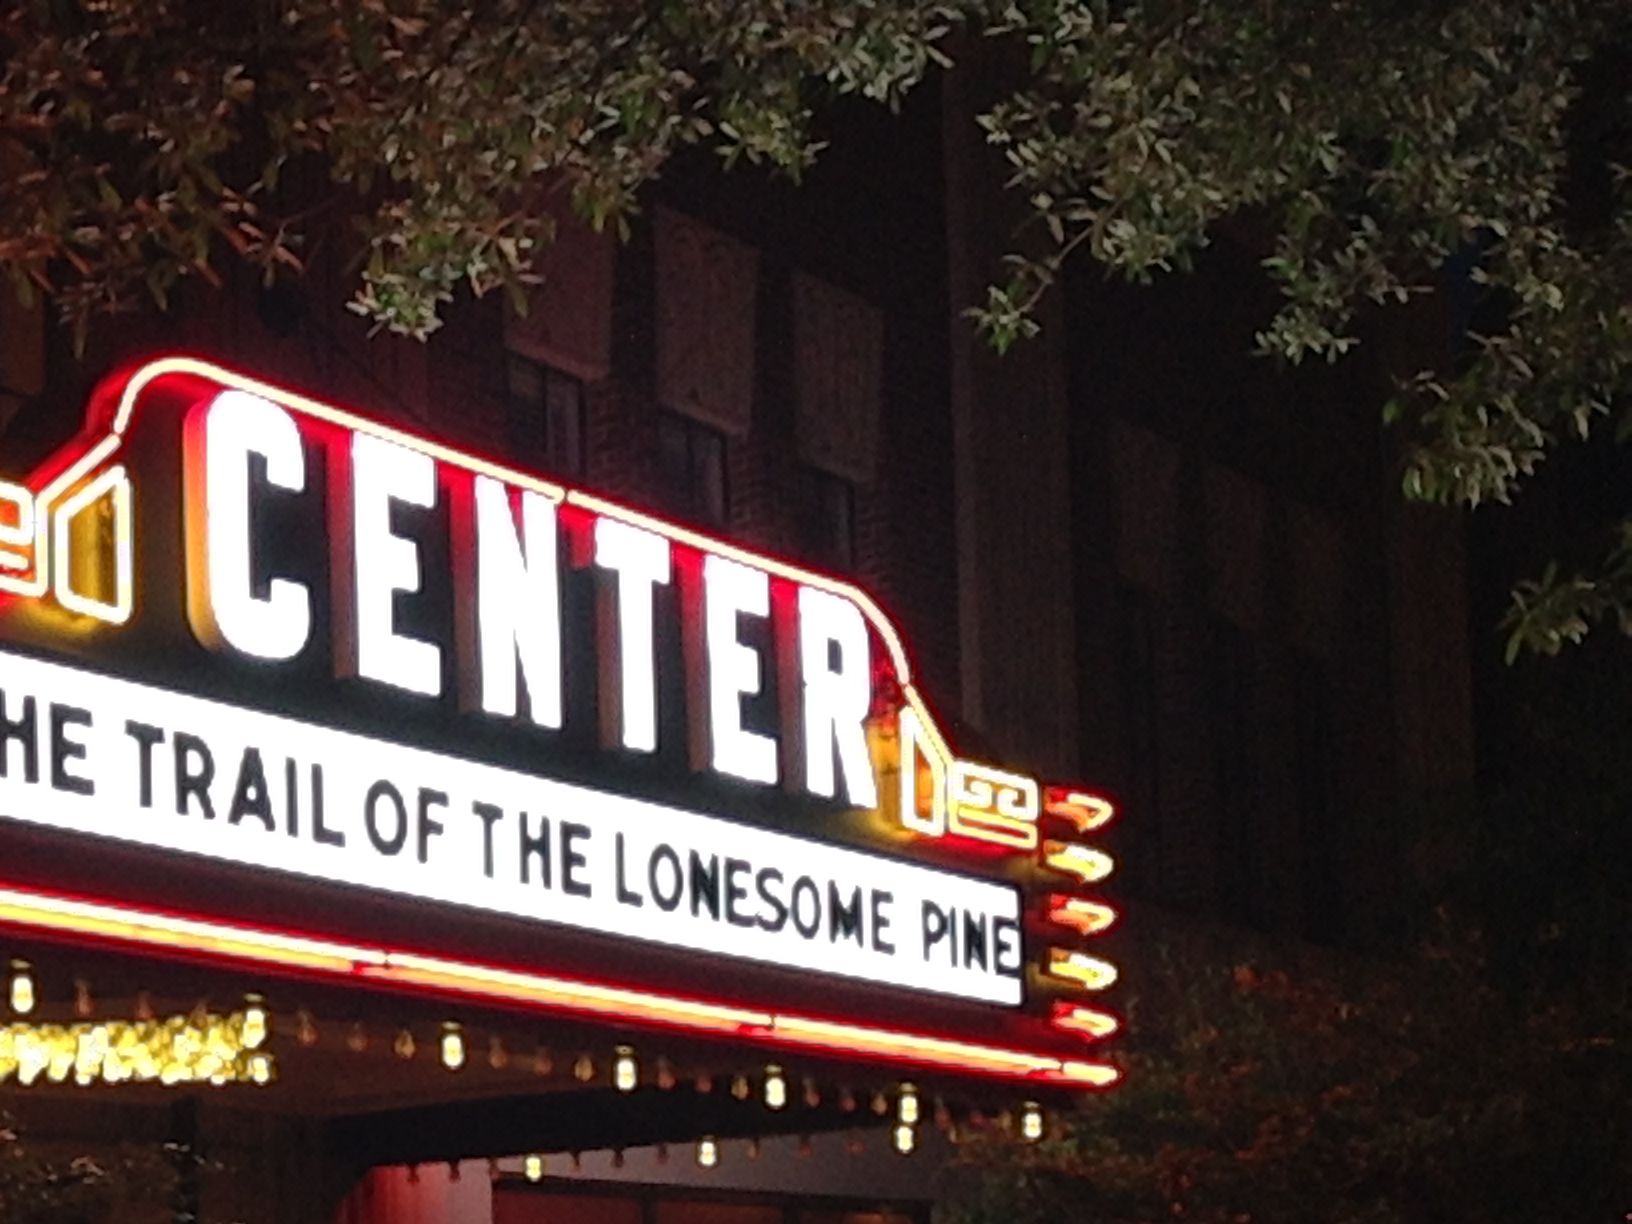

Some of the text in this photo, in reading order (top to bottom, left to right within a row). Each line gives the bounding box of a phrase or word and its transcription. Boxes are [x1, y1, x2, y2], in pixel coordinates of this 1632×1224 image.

[203, 387, 878, 809] CENTER
[124, 718, 346, 847] TRAIL
[364, 778, 449, 863] OF
[472, 800, 592, 898] THE
[614, 831, 896, 955] LONESOME
[920, 899, 1023, 979] PINE
